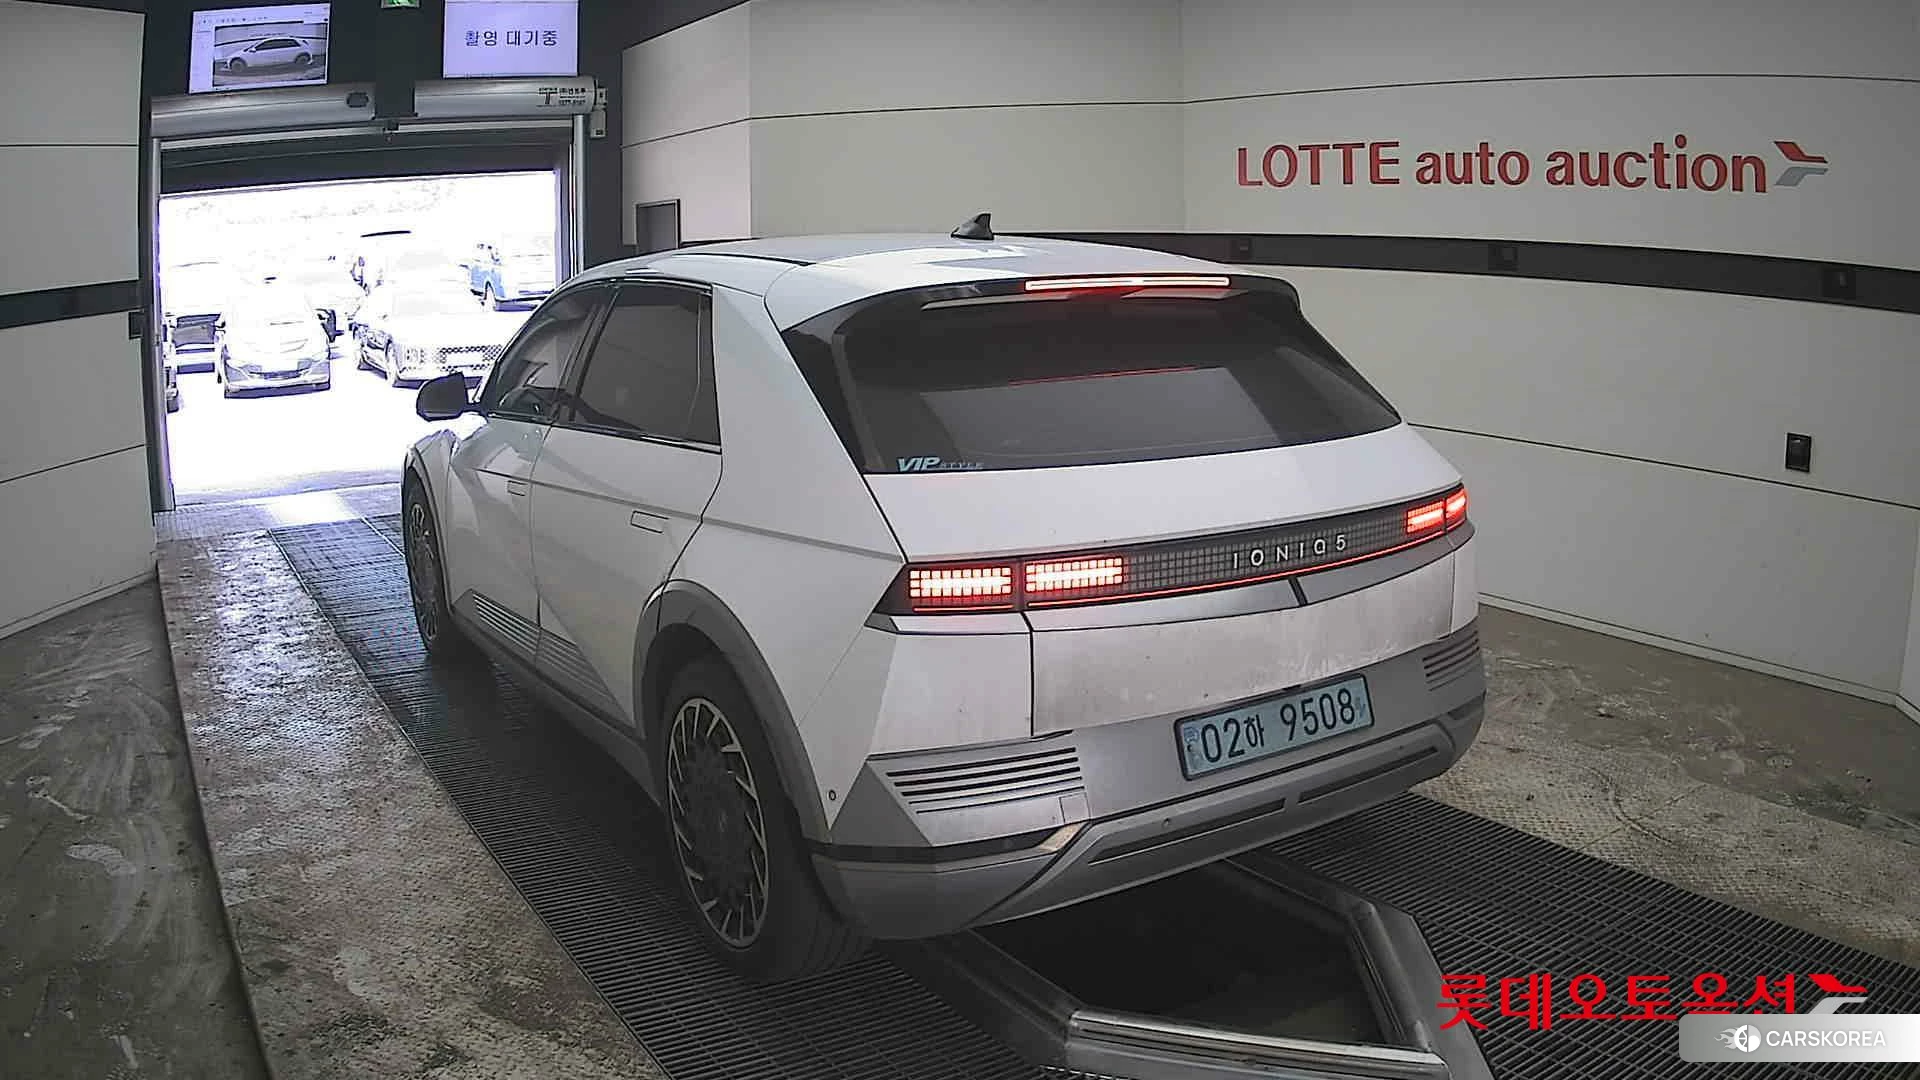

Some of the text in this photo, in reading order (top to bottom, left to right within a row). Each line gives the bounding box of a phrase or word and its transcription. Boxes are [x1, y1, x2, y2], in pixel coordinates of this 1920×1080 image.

[465, 30, 558, 47] 촬영 대기중
[1238, 134, 1768, 194] LOTTE auto auction
[897, 456, 941, 472] VIP
[1200, 687, 1356, 763] 02하 9508
